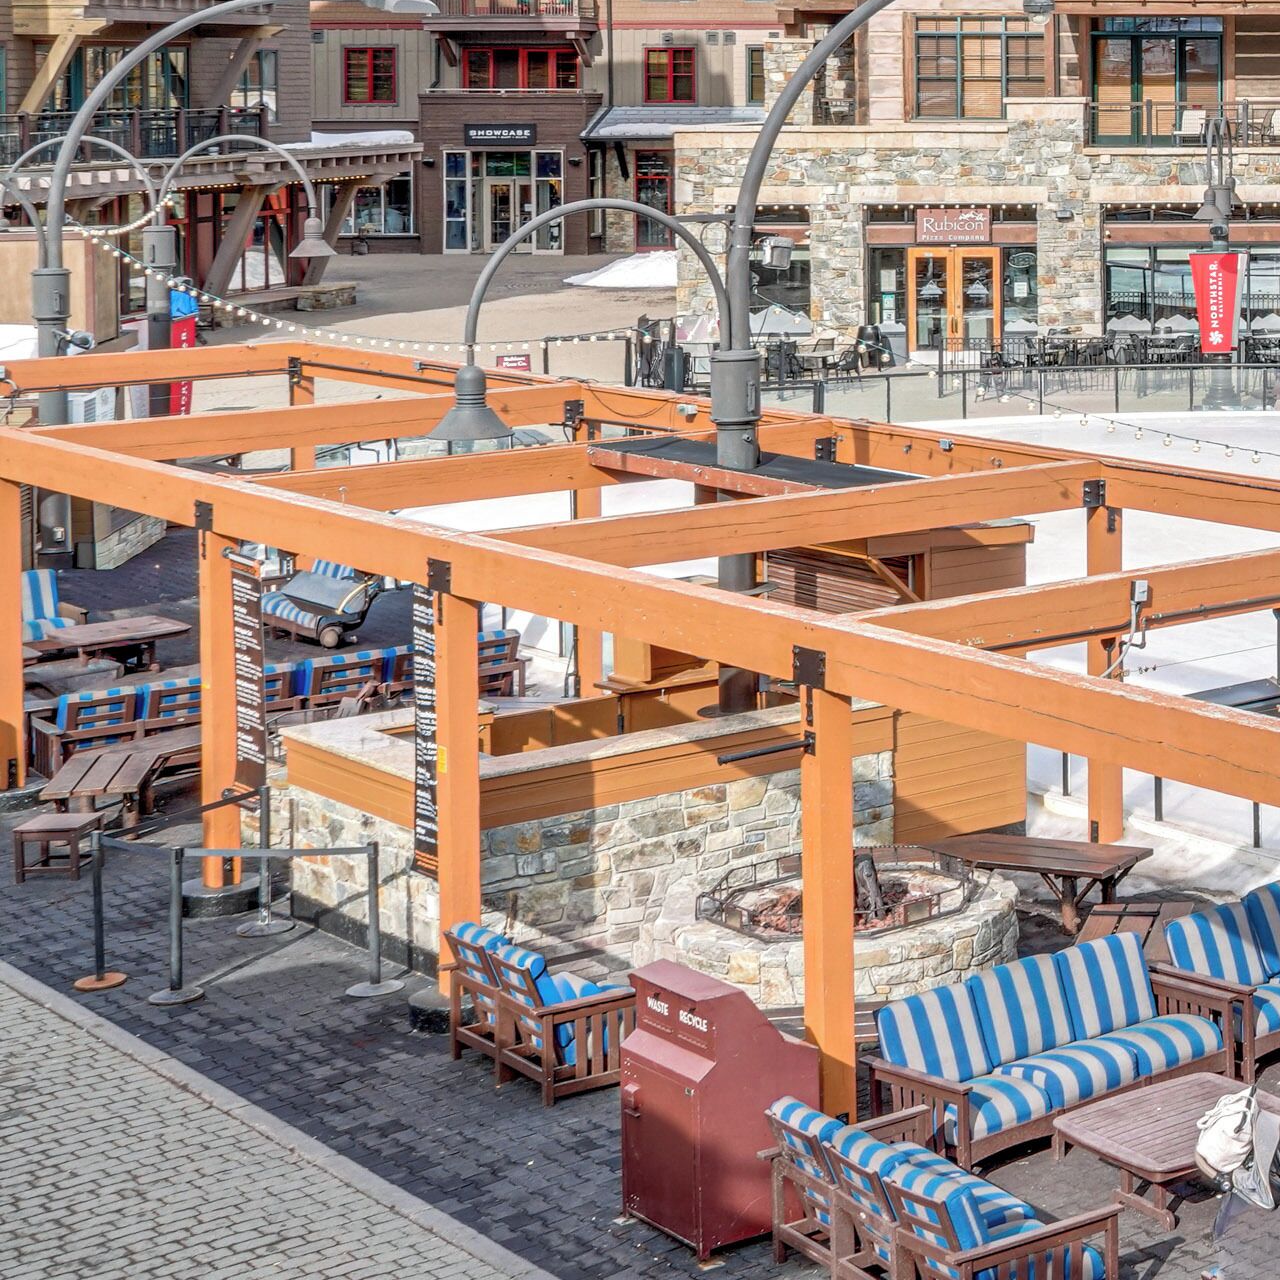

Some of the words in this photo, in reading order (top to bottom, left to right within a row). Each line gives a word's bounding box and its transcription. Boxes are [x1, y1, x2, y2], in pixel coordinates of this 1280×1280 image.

[469, 129, 531, 137] SHOWCASE
[923, 216, 984, 233] Rubicon
[1209, 263, 1219, 328] NORTHSTAR
[647, 996, 669, 1016] WASTE
[679, 1009, 708, 1033] RECYCLE
